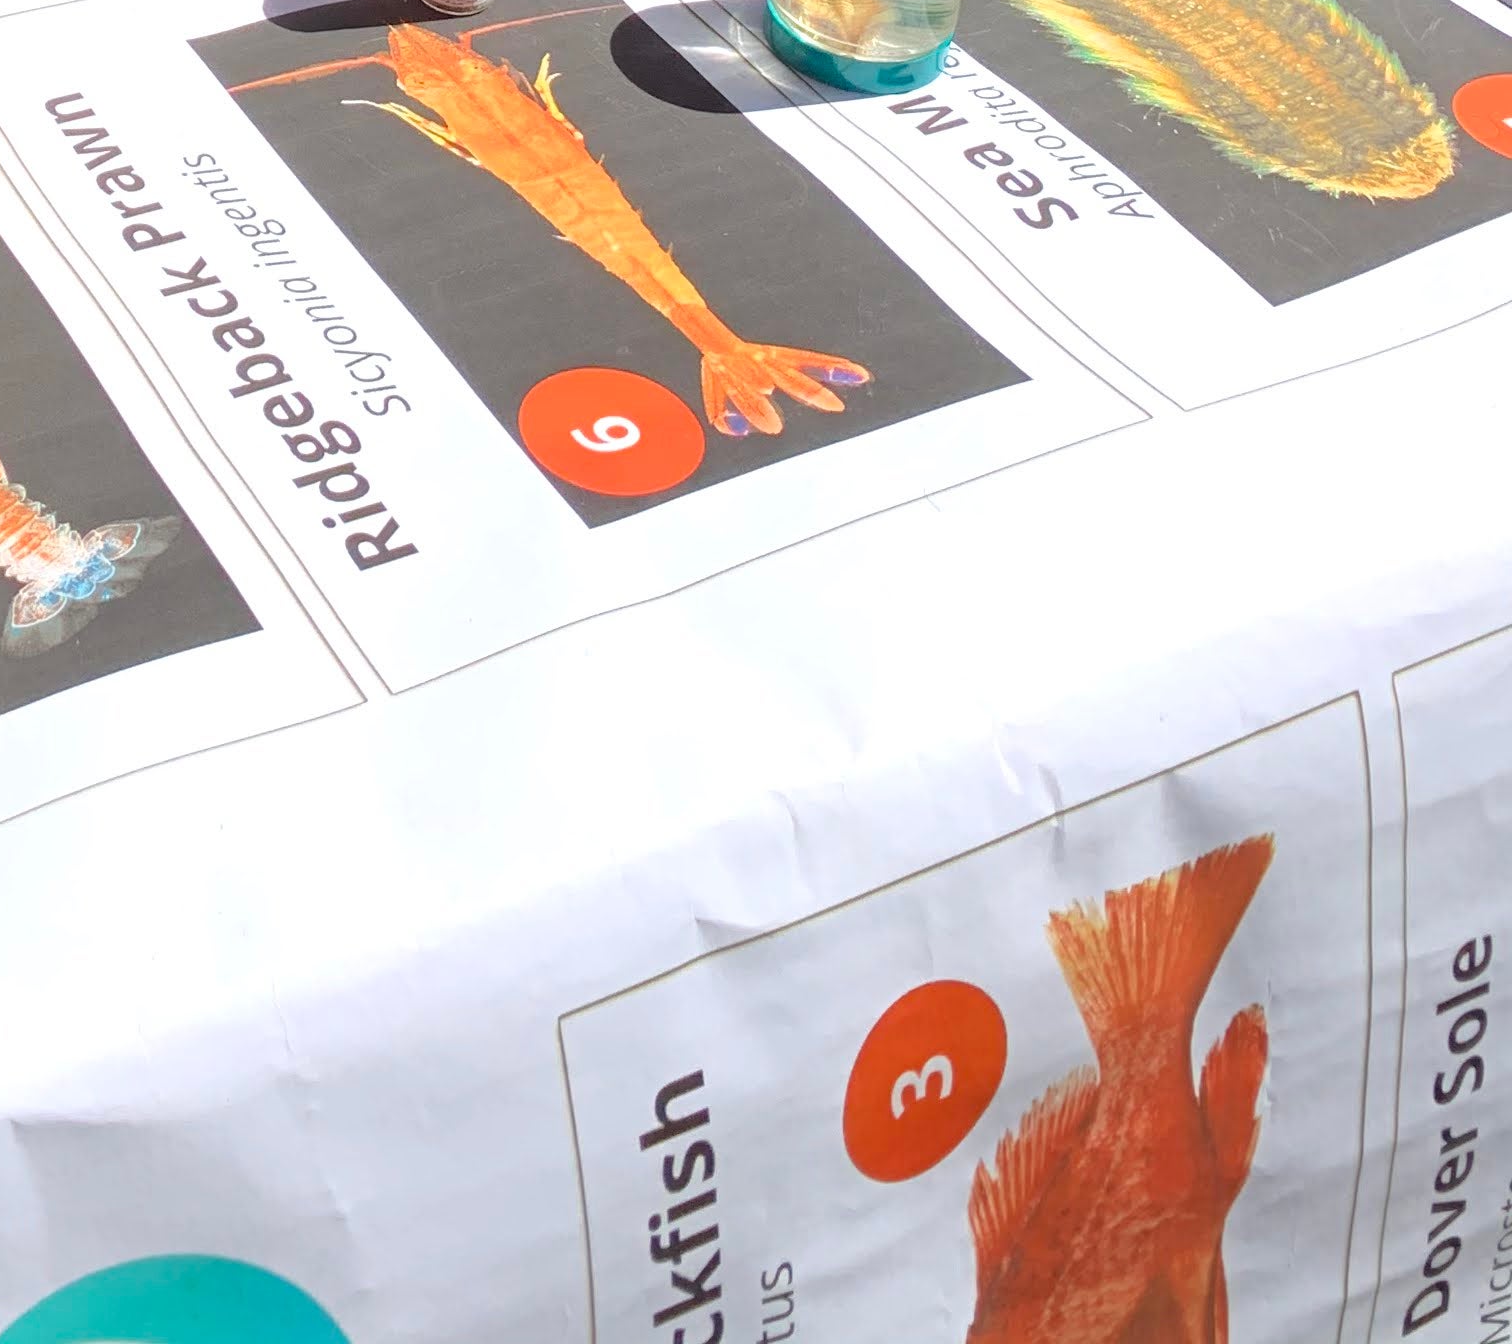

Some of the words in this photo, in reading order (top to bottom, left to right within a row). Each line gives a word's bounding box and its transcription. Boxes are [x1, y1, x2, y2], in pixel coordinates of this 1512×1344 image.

[44, 92, 187, 252] Prawn
[181, 152, 297, 269] ingentis
[963, 141, 1079, 230] Sea
[968, 85, 1155, 220] Aphrodita
[161, 255, 419, 572] Ridgeback
[278, 274, 411, 417] Sicyonia
[570, 414, 641, 452] 6
[1433, 933, 1495, 1096] Sole
[890, 1054, 954, 1120] 3
[638, 1067, 725, 1344] ckfish
[1401, 1116, 1482, 1338] Dover
